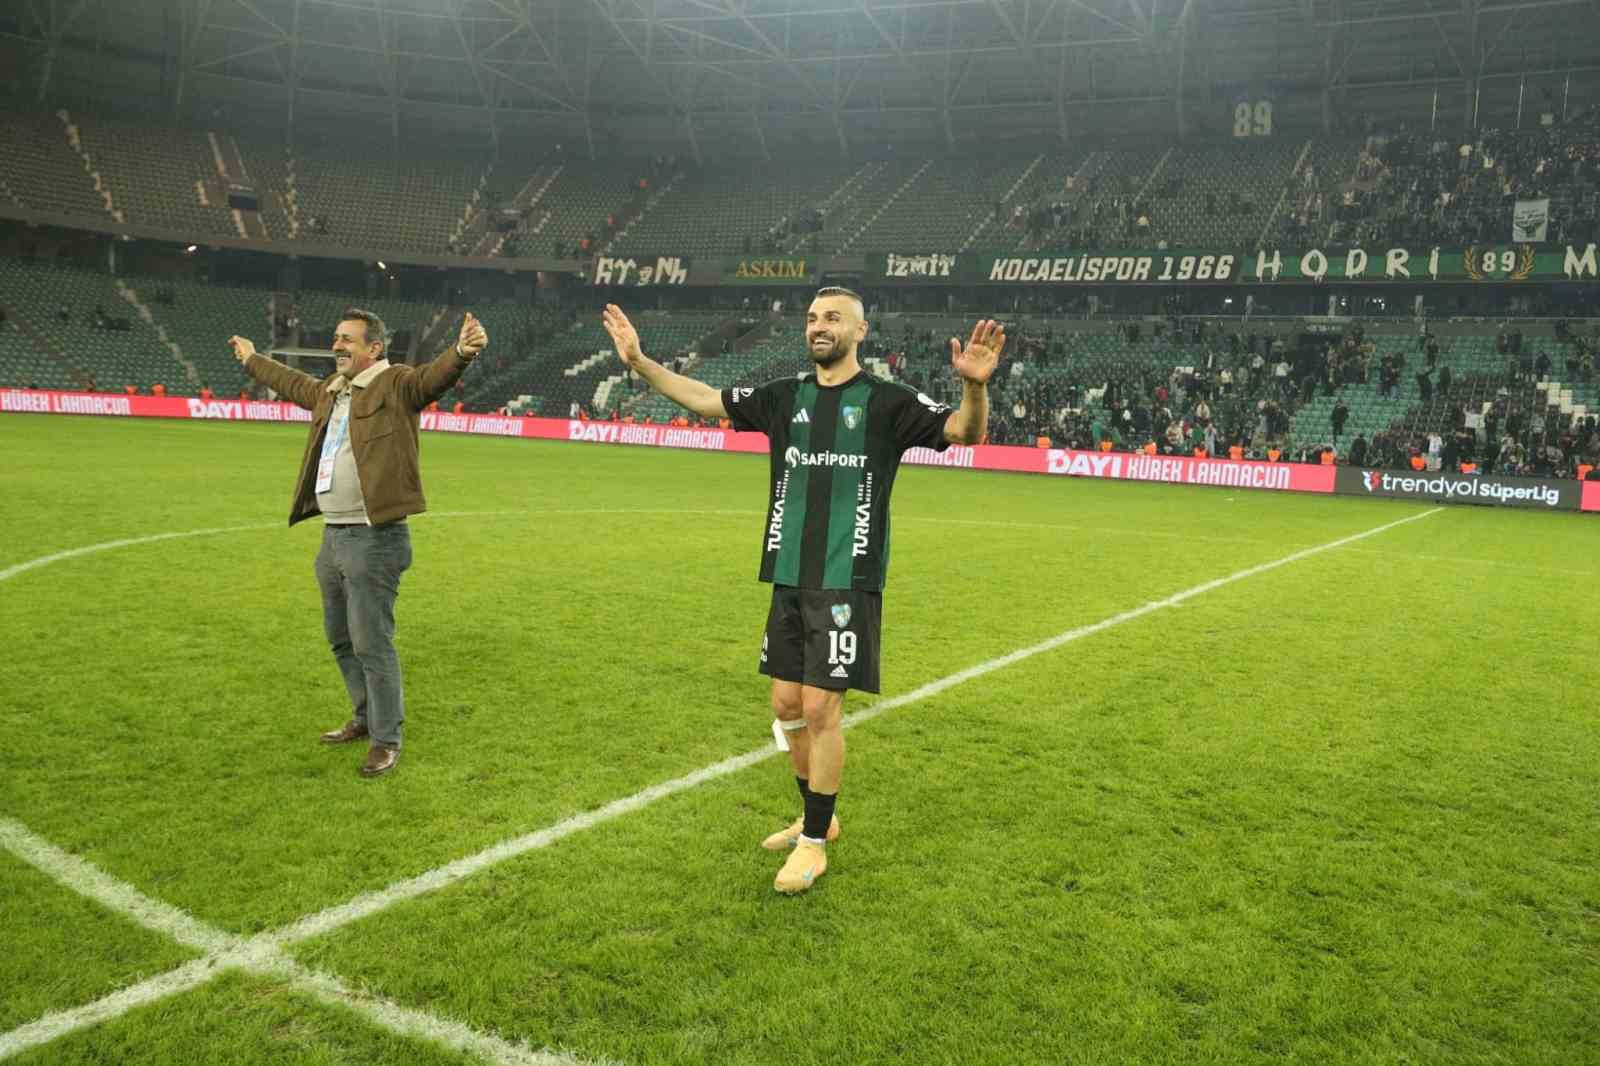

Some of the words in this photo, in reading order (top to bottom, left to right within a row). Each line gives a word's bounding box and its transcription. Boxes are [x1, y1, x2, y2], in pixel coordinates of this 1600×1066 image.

[1233, 101, 1272, 136] 89
[990, 254, 1152, 281] KOCAELİSPOR
[1158, 255, 1234, 280] 1966
[1482, 252, 1516, 272] 89
[54, 395, 131, 415] LAHMACUN
[187, 398, 243, 418] DAYI
[659, 428, 725, 449] LAHMACUN
[801, 450, 868, 468] SAFİPORT
[1047, 449, 1121, 477] DAYI
[1126, 456, 1182, 482] KÜREK
[1186, 460, 1290, 488] LAHMACUN
[1382, 470, 1477, 498] trendyol
[768, 500, 785, 552] TURKA
[852, 503, 872, 557] TURKA
[828, 630, 857, 664] 19
